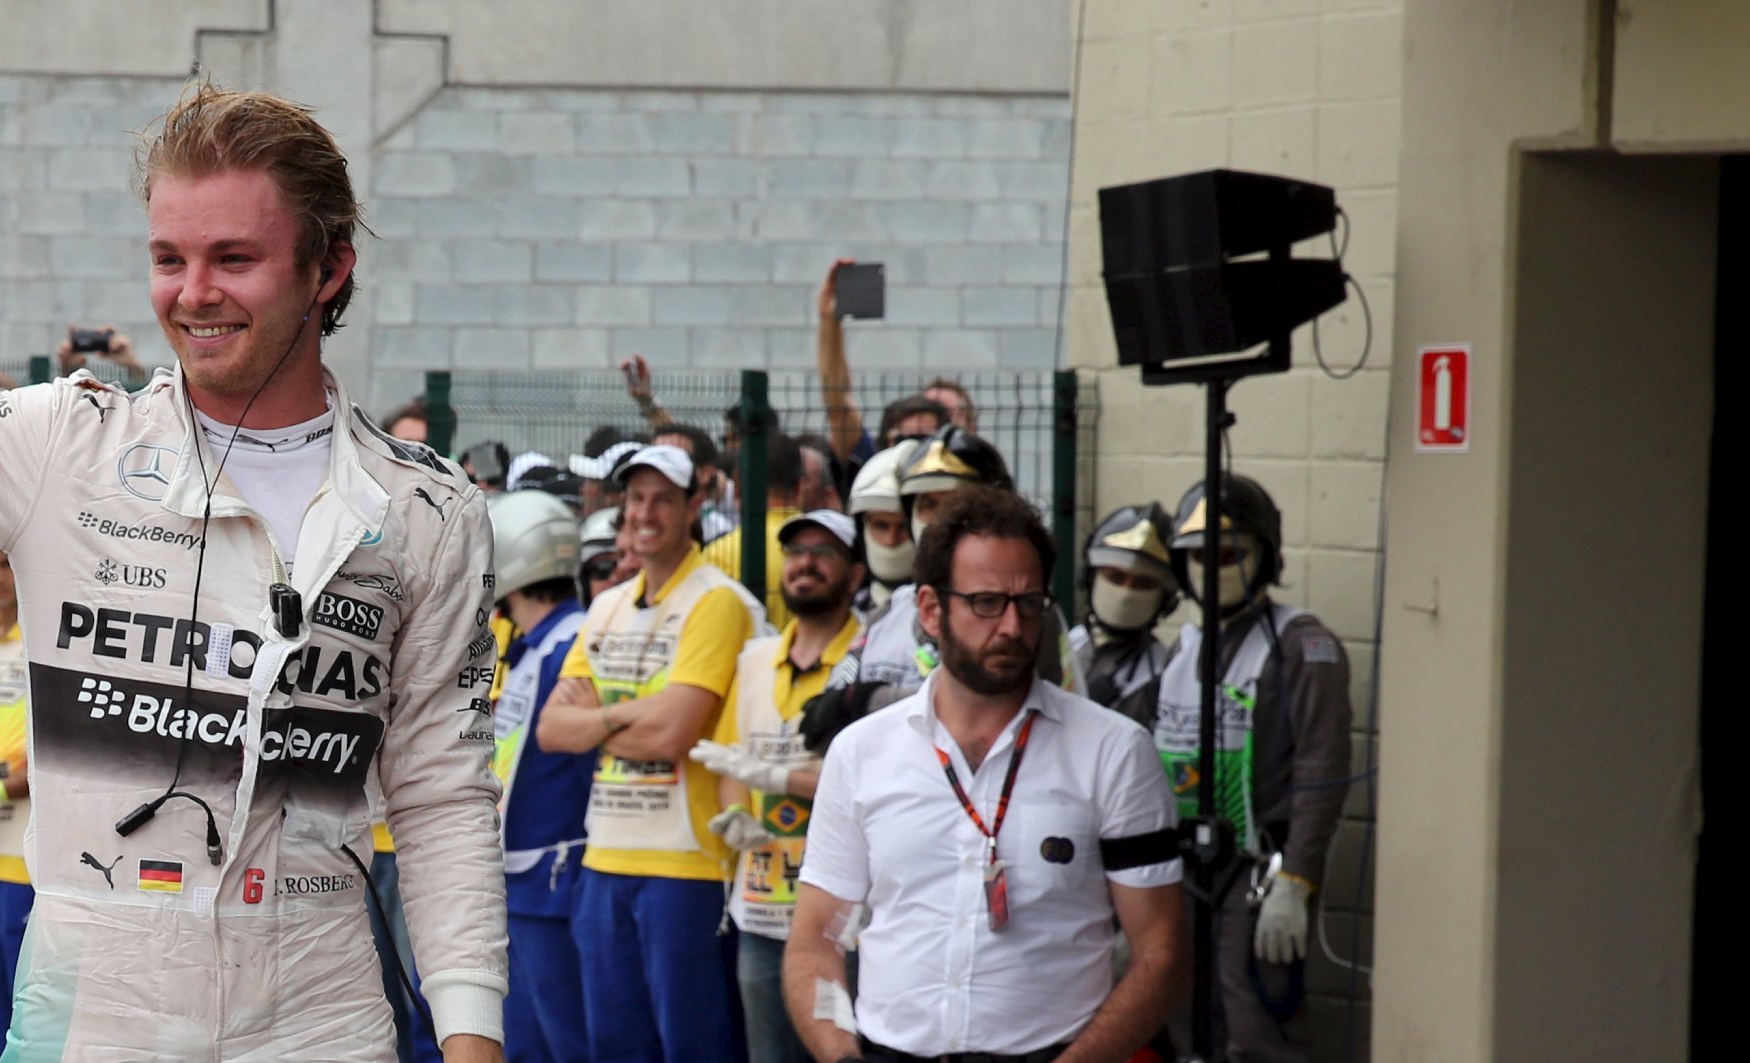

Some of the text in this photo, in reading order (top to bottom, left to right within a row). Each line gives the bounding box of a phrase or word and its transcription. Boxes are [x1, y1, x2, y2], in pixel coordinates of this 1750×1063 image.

[99, 519, 201, 550] BlackBerry
[123, 564, 167, 588] UBS
[315, 615, 346, 628] HUGO
[317, 593, 381, 630] BOSS
[127, 694, 362, 774] Blackerry
[242, 868, 265, 904] 6
